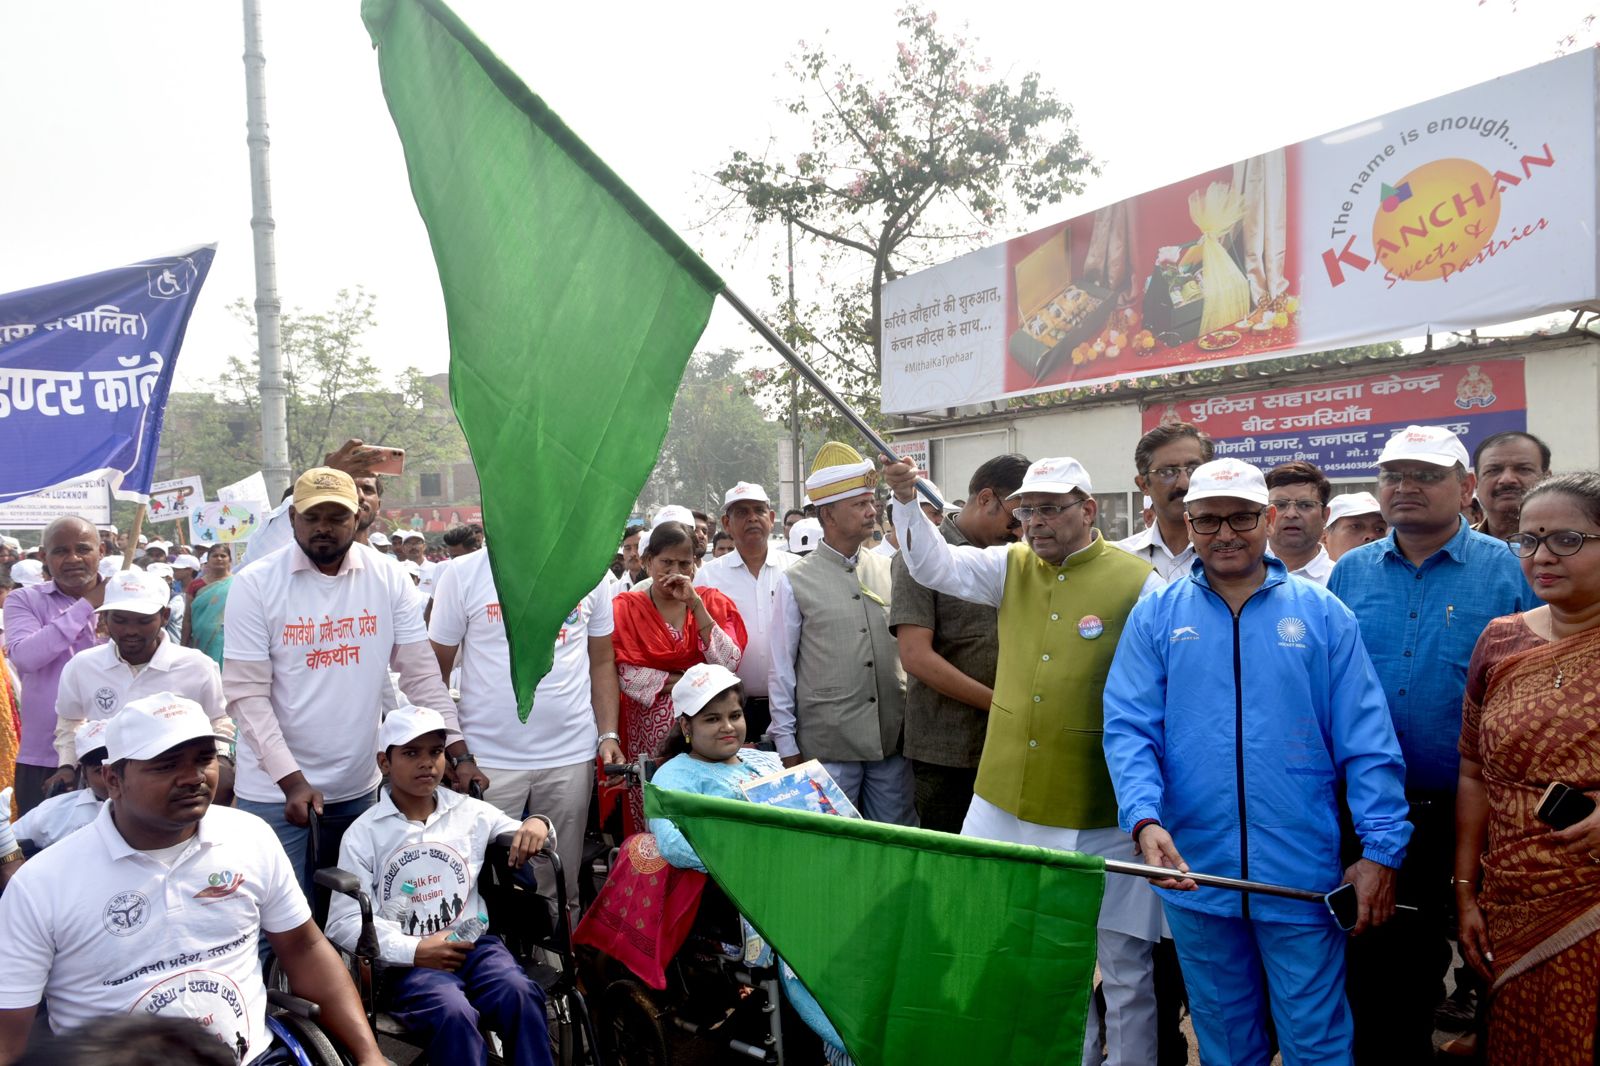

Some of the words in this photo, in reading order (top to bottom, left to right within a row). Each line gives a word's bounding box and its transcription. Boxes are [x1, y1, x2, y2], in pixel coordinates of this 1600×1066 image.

[1331, 200, 1353, 239] The
[1349, 145, 1396, 195] name
[1400, 128, 1420, 146] is
[1427, 115, 1518, 150] enough...
[1321, 143, 1556, 288] KANCHAN
[1384, 241, 1459, 289] Sweets
[1464, 218, 1489, 239] &
[1440, 217, 1549, 283] Pastries
[884, 309, 907, 330] करिये
[943, 294, 957, 314] की
[891, 335, 914, 353] कंचन
[916, 327, 945, 348] स्वीट्स
[947, 320, 957, 339] के
[904, 351, 974, 374] #MithaiKaTyohaar
[1189, 396, 1256, 423] पुलिस
[1262, 383, 1364, 409] सहायता
[1371, 374, 1444, 396] केन्द्र
[1241, 414, 1276, 433] बीट
[1212, 437, 1256, 456] गोमती
[1259, 436, 1303, 452] नगर,
[1308, 430, 1368, 448] जनपद
[52, 491, 88, 499] LUCKNOW
[306, 643, 361, 670] वॉकथॉन
[427, 874, 442, 884] For
[410, 889, 444, 904] nclusion
